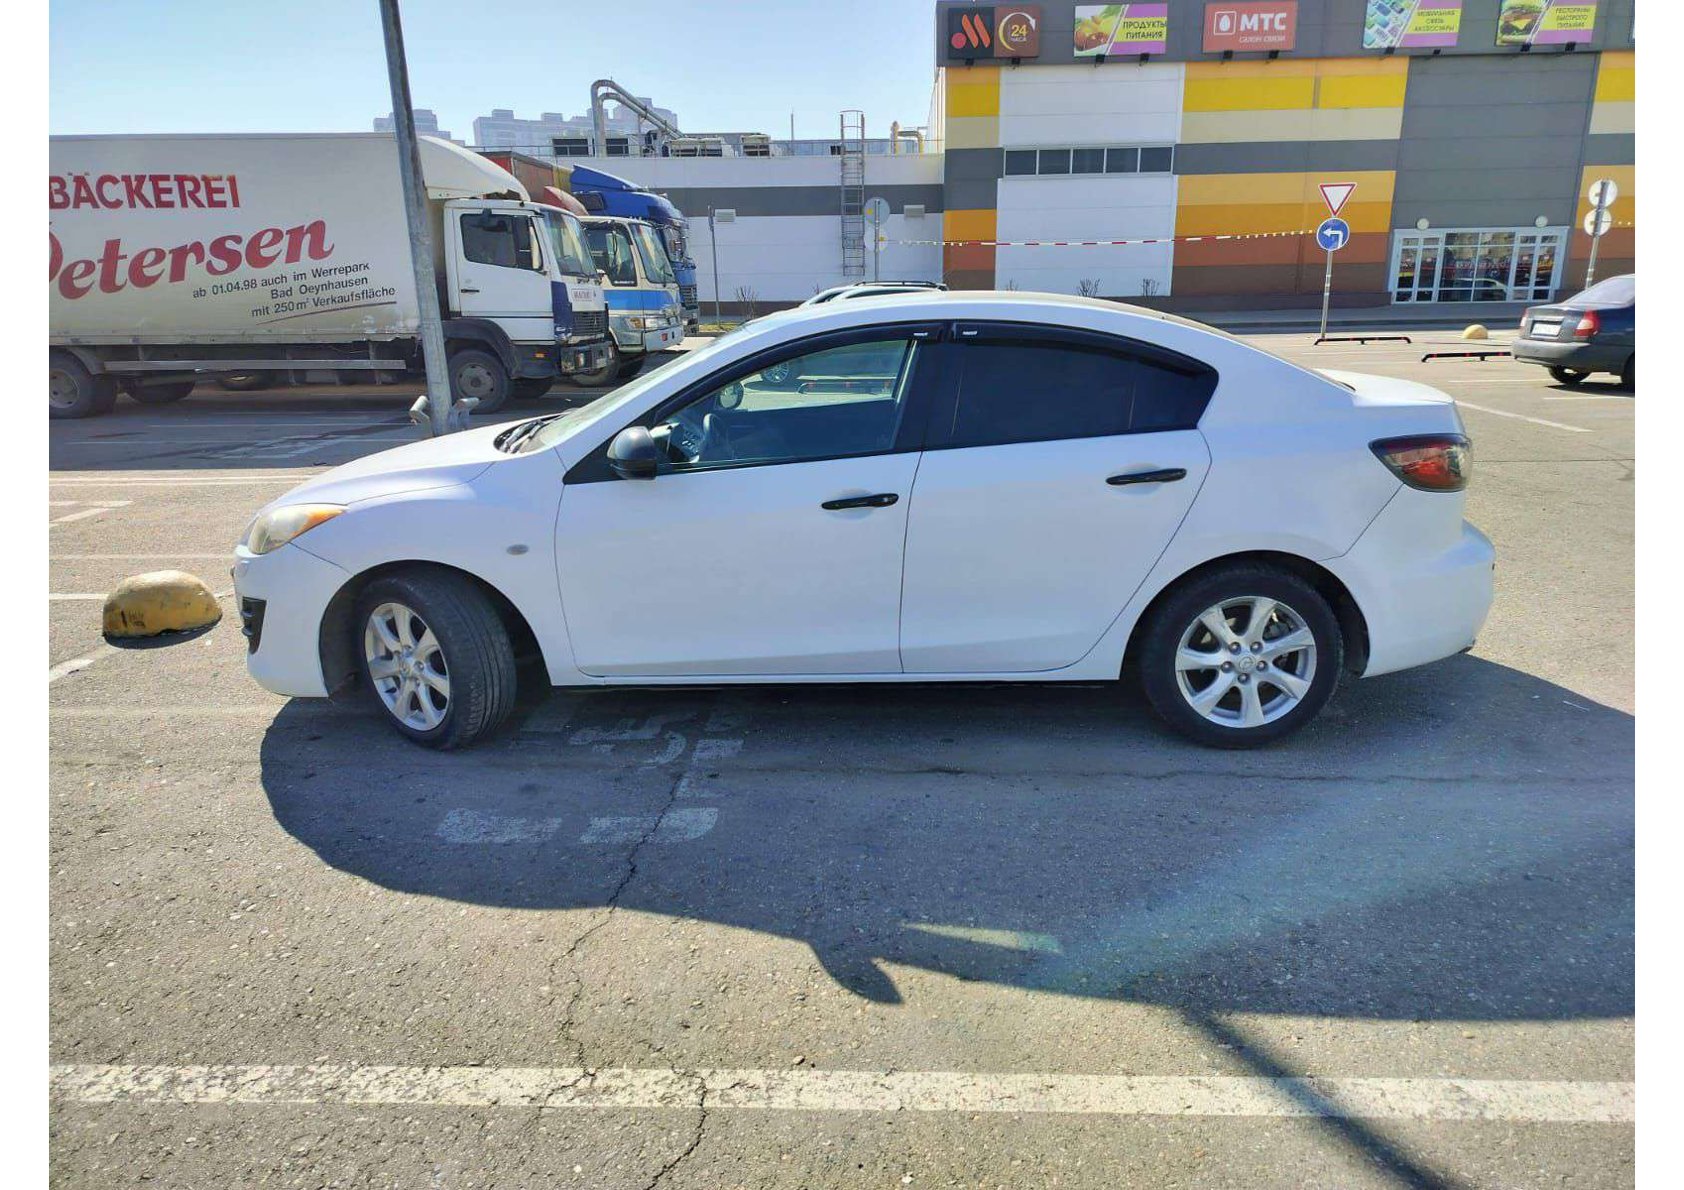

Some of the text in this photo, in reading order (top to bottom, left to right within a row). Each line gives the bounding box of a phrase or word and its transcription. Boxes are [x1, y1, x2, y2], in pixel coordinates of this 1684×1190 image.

[1011, 24, 1027, 37] 24
[1123, 20, 1167, 29] ПРОДУКТЫ
[1240, 12, 1287, 32] МТС
[1126, 31, 1163, 39] ПИТАНИЯ
[192, 262, 370, 299] ab 01.04.98 auch im Werrepark
[270, 276, 368, 300] Bad Oeynhausen
[251, 305, 270, 318] mit
[312, 286, 396, 307] Verkaufsfläche
